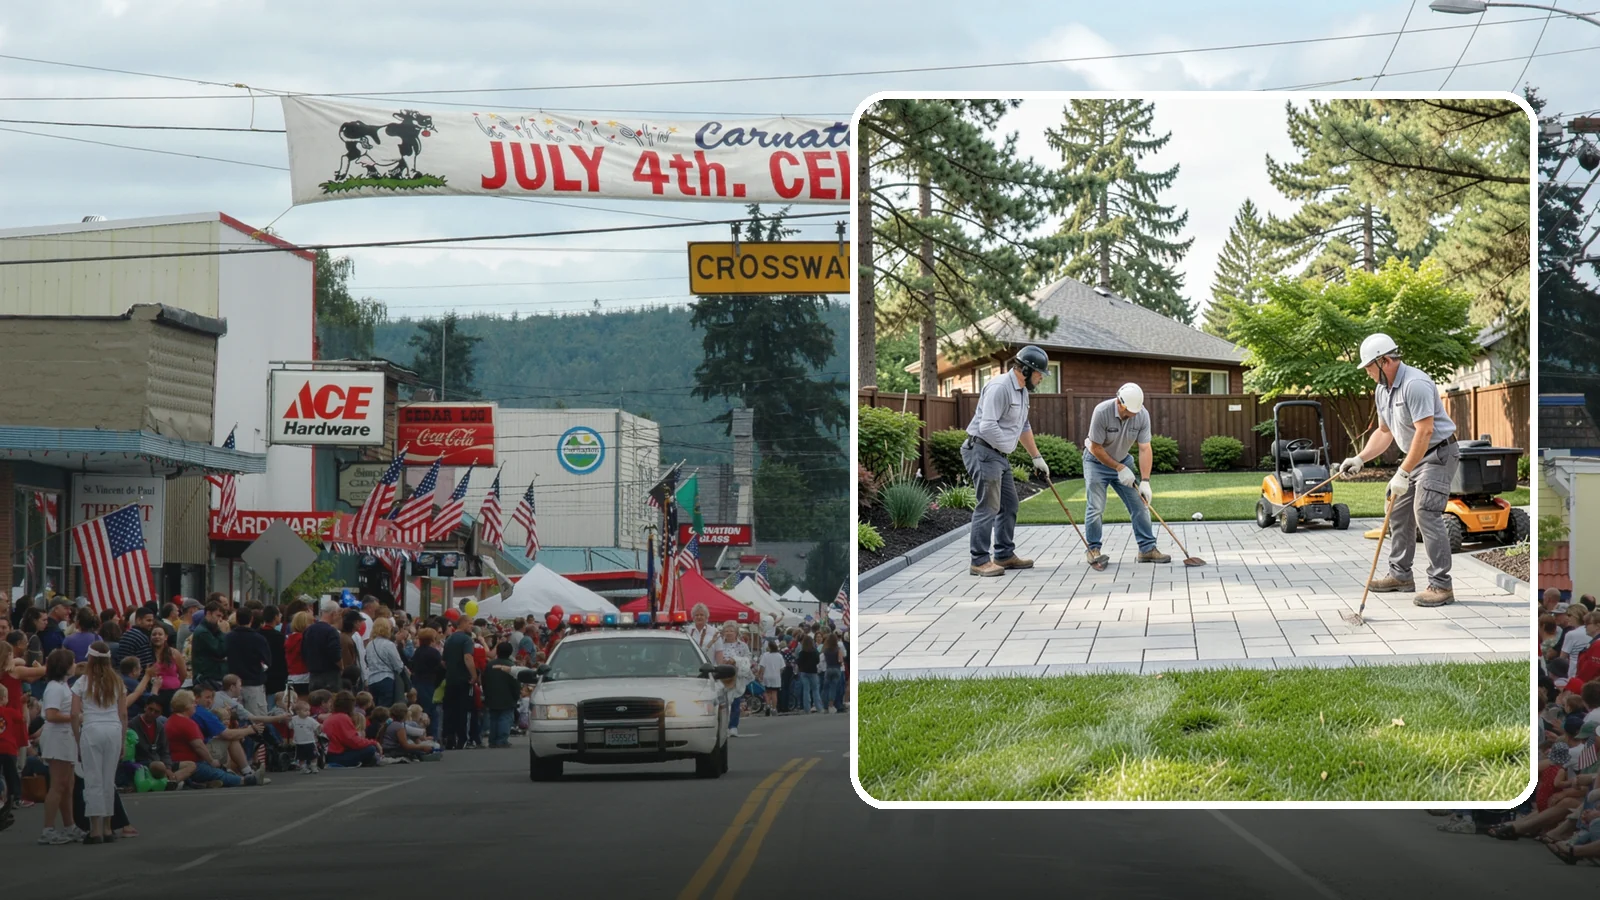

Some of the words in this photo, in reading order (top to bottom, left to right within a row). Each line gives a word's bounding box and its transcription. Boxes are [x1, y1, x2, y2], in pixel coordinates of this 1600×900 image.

[481, 140, 605, 193] JULY
[632, 149, 747, 198] 4th.
[696, 254, 850, 280] CROSSWA
[282, 379, 374, 420] ACE
[405, 409, 453, 422] CEDAR
[283, 420, 371, 437] Hardware
[416, 427, 477, 447] Coca-Cola
[353, 467, 386, 481] Simpl
[83, 485, 93, 494] St.
[95, 485, 124, 495] Vincent
[126, 486, 136, 495] de
[137, 485, 155, 496] Paul
[212, 516, 331, 537] HARDARE
[688, 526, 741, 535] CRNATION
[699, 535, 731, 543] GLASS
